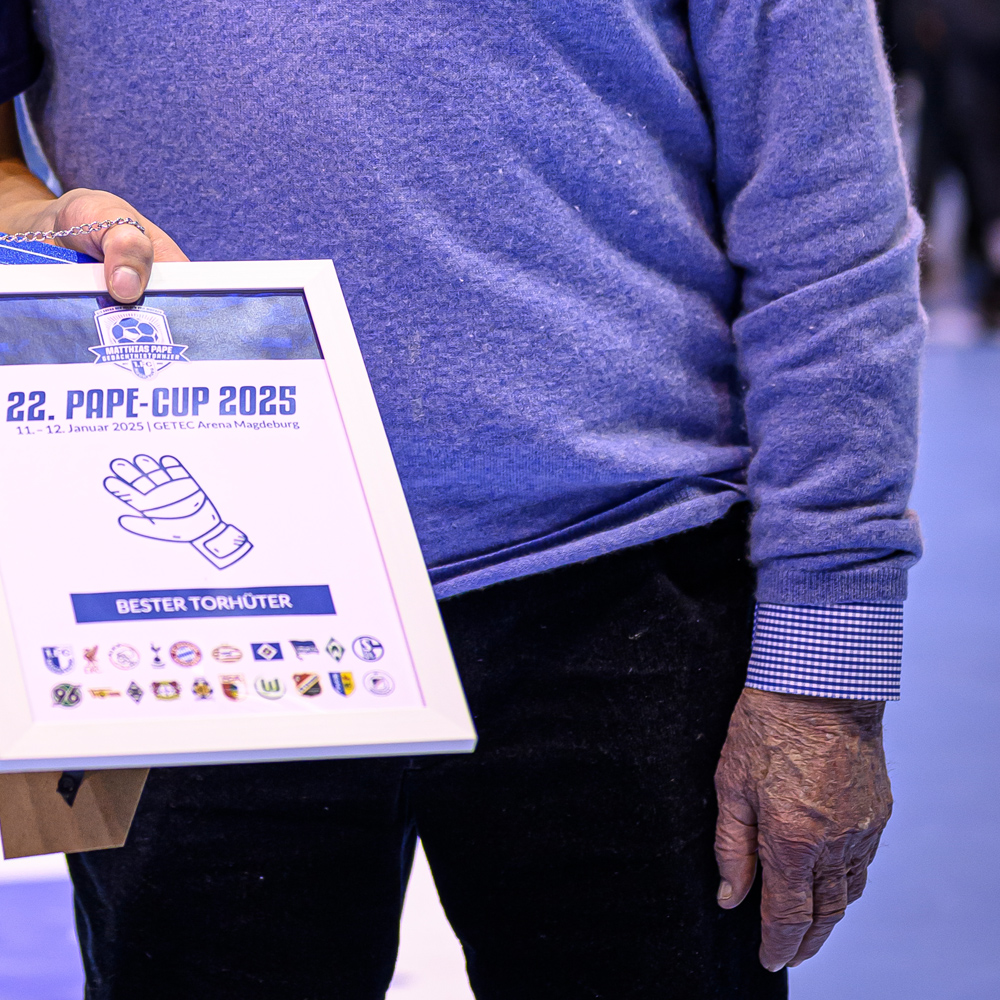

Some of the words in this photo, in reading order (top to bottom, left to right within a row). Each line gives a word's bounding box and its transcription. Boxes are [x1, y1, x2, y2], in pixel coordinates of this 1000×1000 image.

[104, 345, 150, 355] MATTHIAS
[151, 345, 174, 354] PAPE
[6, 390, 55, 422] 22.
[66, 386, 210, 420] PAPE-CUP
[218, 385, 297, 416] 2025
[68, 423, 109, 434] Januar
[112, 421, 145, 432] 2025
[153, 420, 196, 431] GETEC
[197, 420, 232, 430] Arena
[234, 419, 300, 431] Magdeburg
[115, 595, 188, 615] BESTER
[188, 592, 294, 612] TORHÜTER
